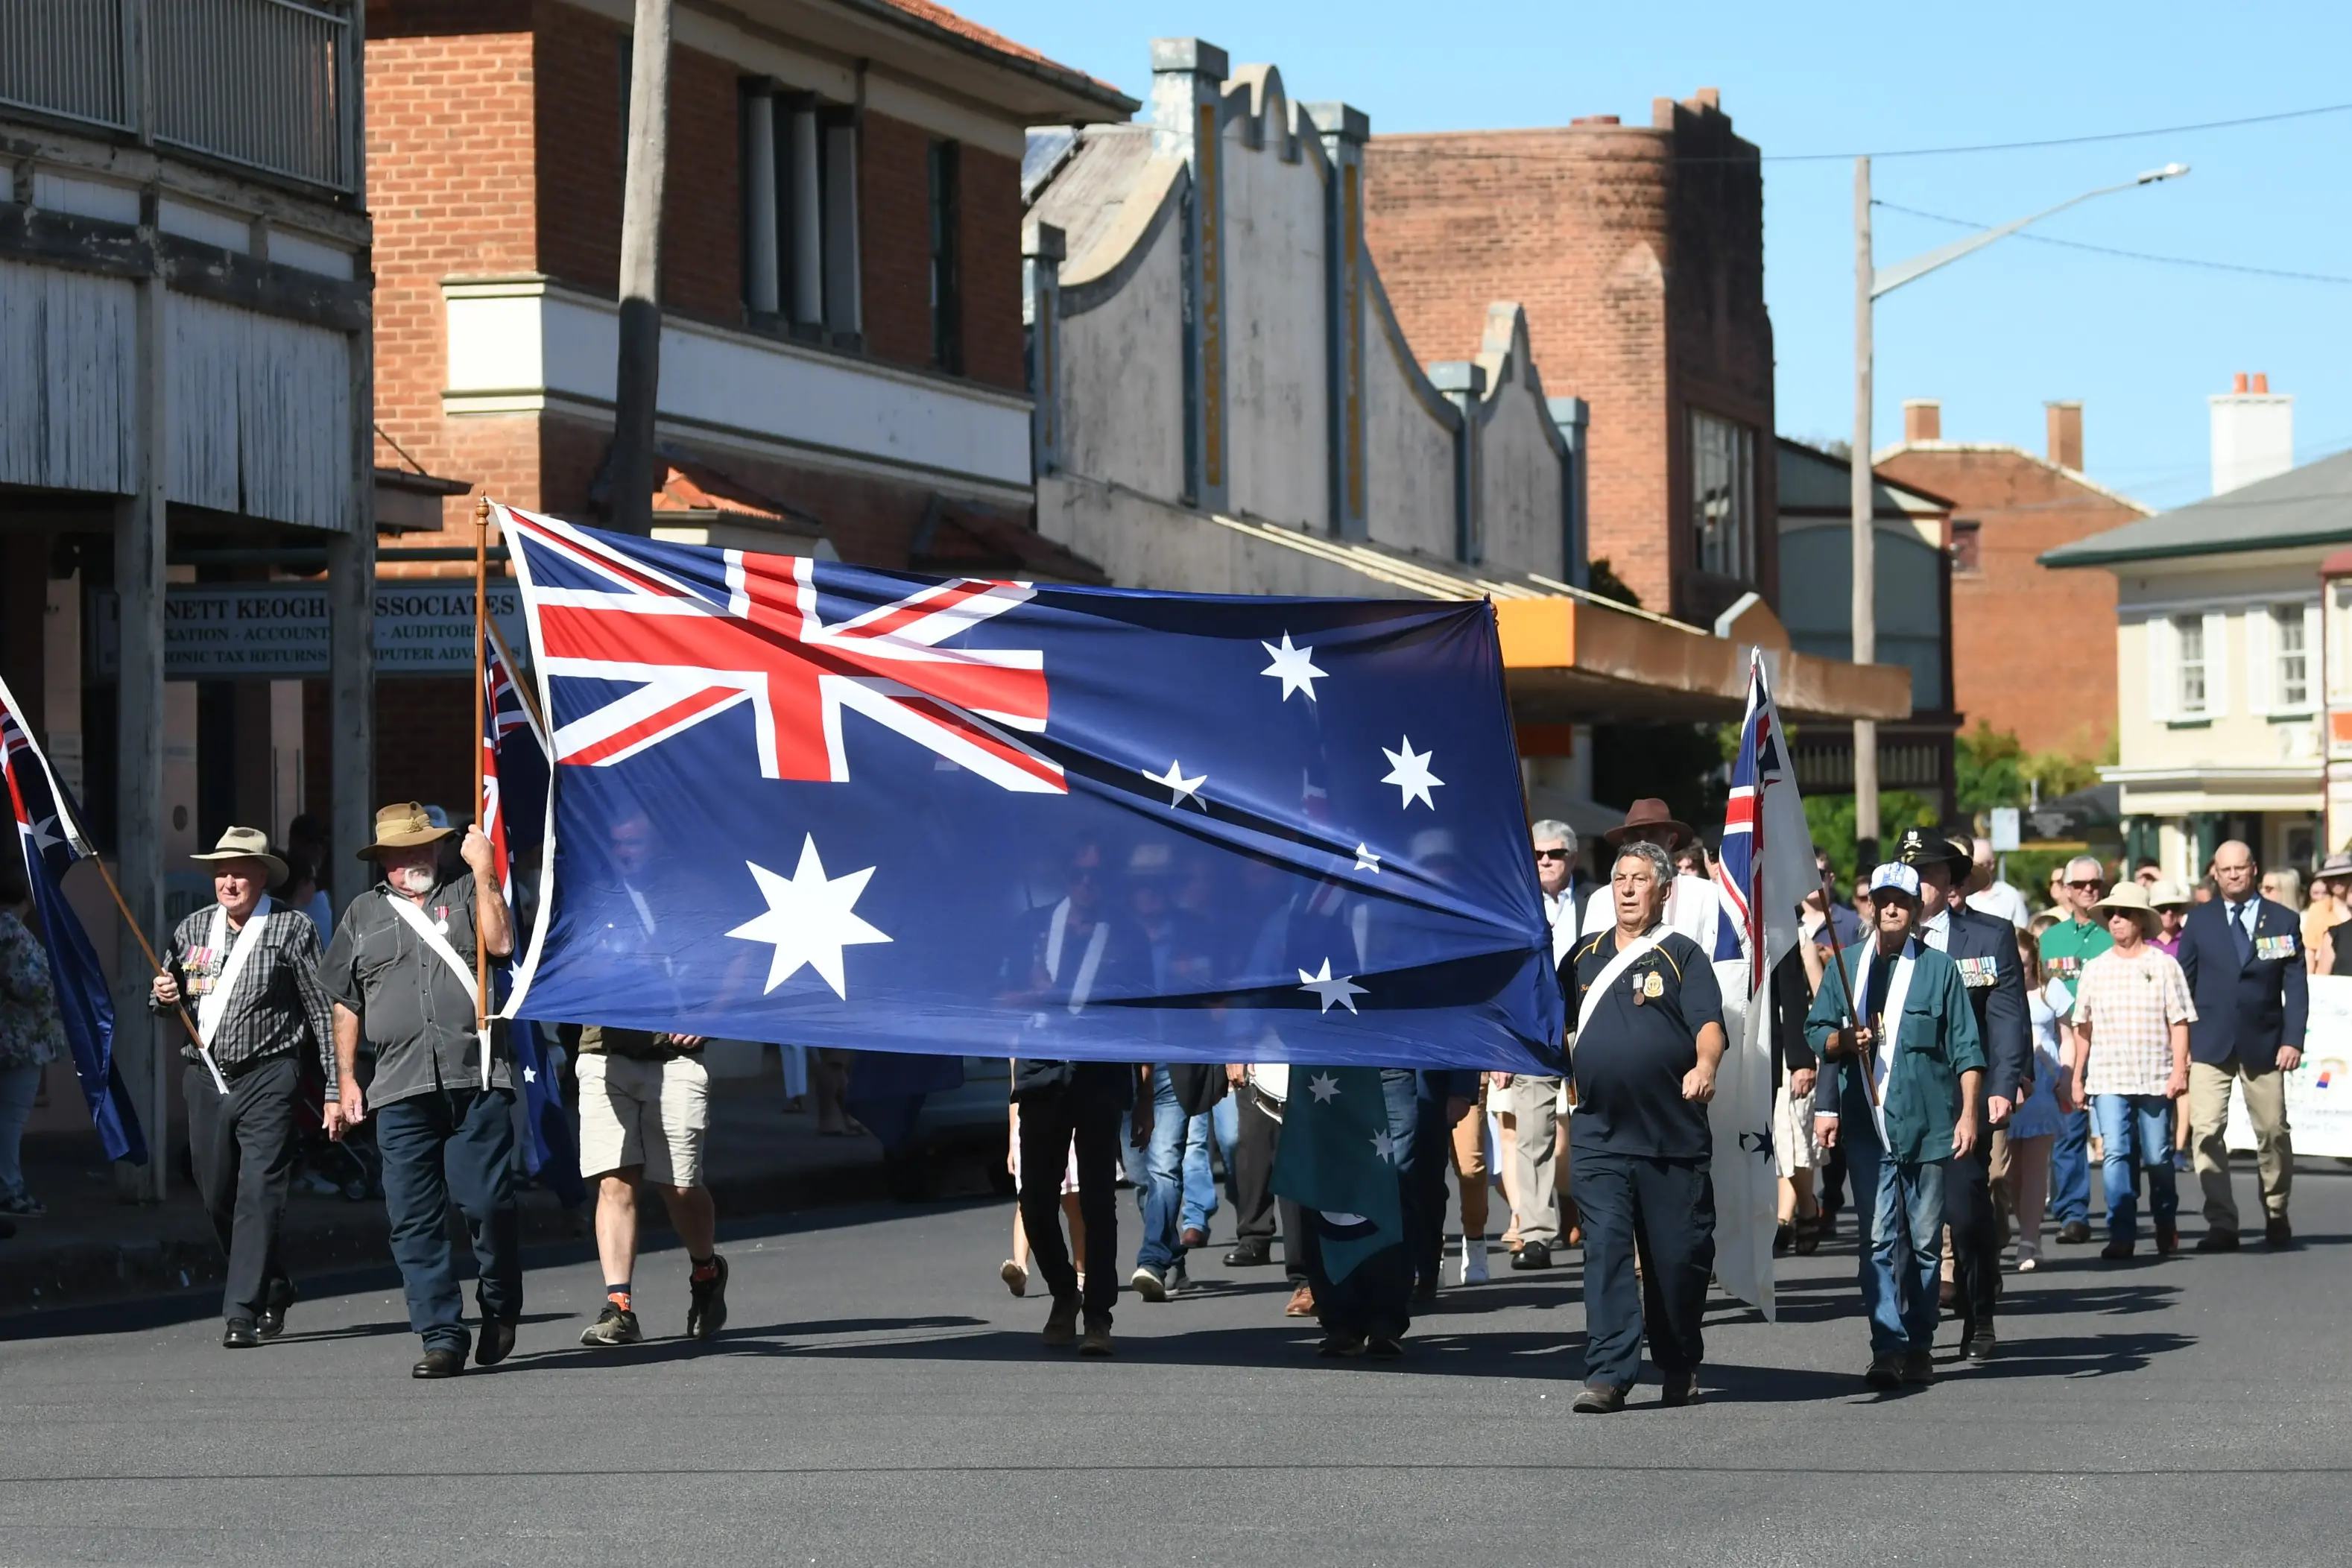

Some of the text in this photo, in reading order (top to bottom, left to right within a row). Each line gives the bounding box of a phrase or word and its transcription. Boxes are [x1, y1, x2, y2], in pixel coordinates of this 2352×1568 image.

[236, 597, 326, 619] KEOGH
[213, 650, 244, 663] TAX
[249, 648, 328, 663] RETURNS
